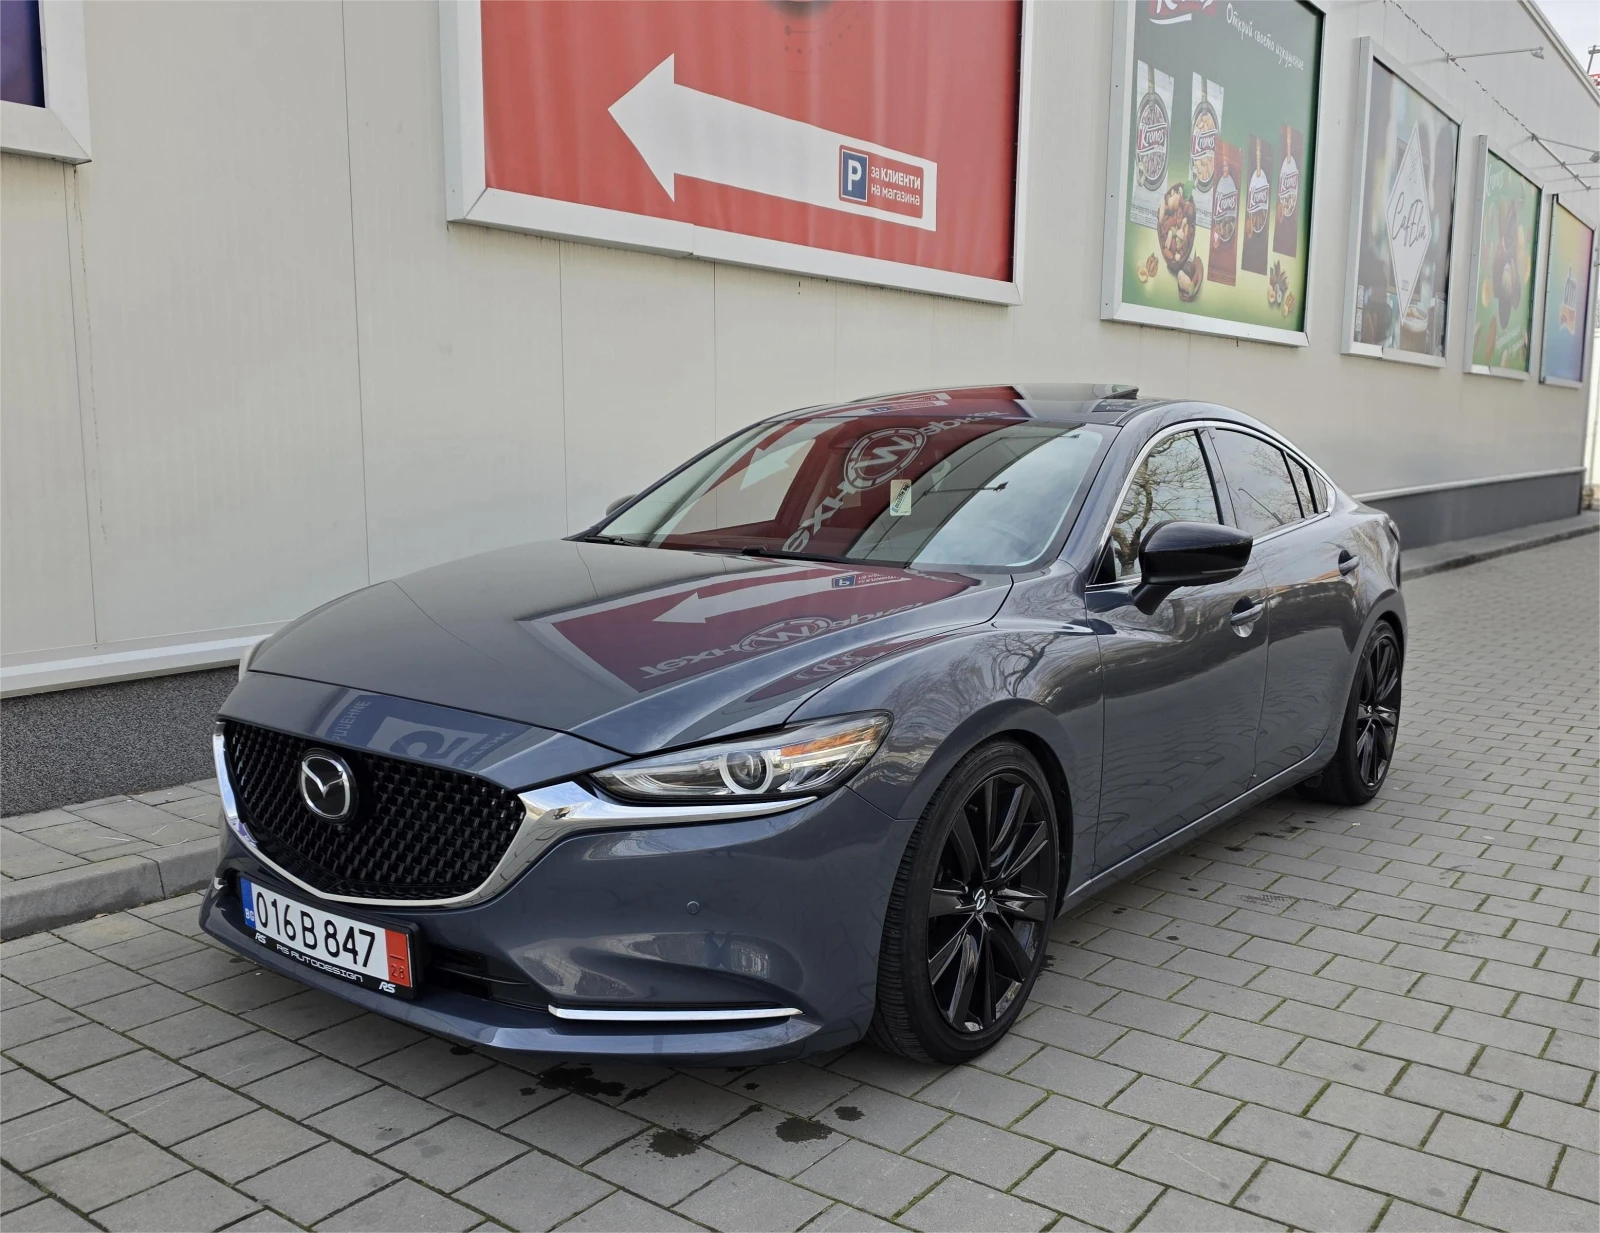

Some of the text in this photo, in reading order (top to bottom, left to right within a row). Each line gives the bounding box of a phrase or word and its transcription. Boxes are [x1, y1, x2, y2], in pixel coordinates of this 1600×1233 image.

[1226, 3, 1253, 39] Открий
[1254, 33, 1274, 51] своето
[1276, 44, 1304, 71] изкушение
[1140, 125, 1164, 149] Kronos
[1194, 131, 1215, 154] Kronos
[847, 159, 862, 191] P
[870, 166, 920, 190] за КЛИЕНТИ
[1280, 172, 1297, 193] Kronos
[871, 183, 920, 206] на магазина
[1216, 192, 1235, 215] Kronos
[1250, 186, 1267, 208] Kronos
[244, 908, 255, 922] BG
[255, 932, 267, 945] RS
[276, 943, 363, 983] RS AUTODESIGN
[378, 981, 396, 994] RS
